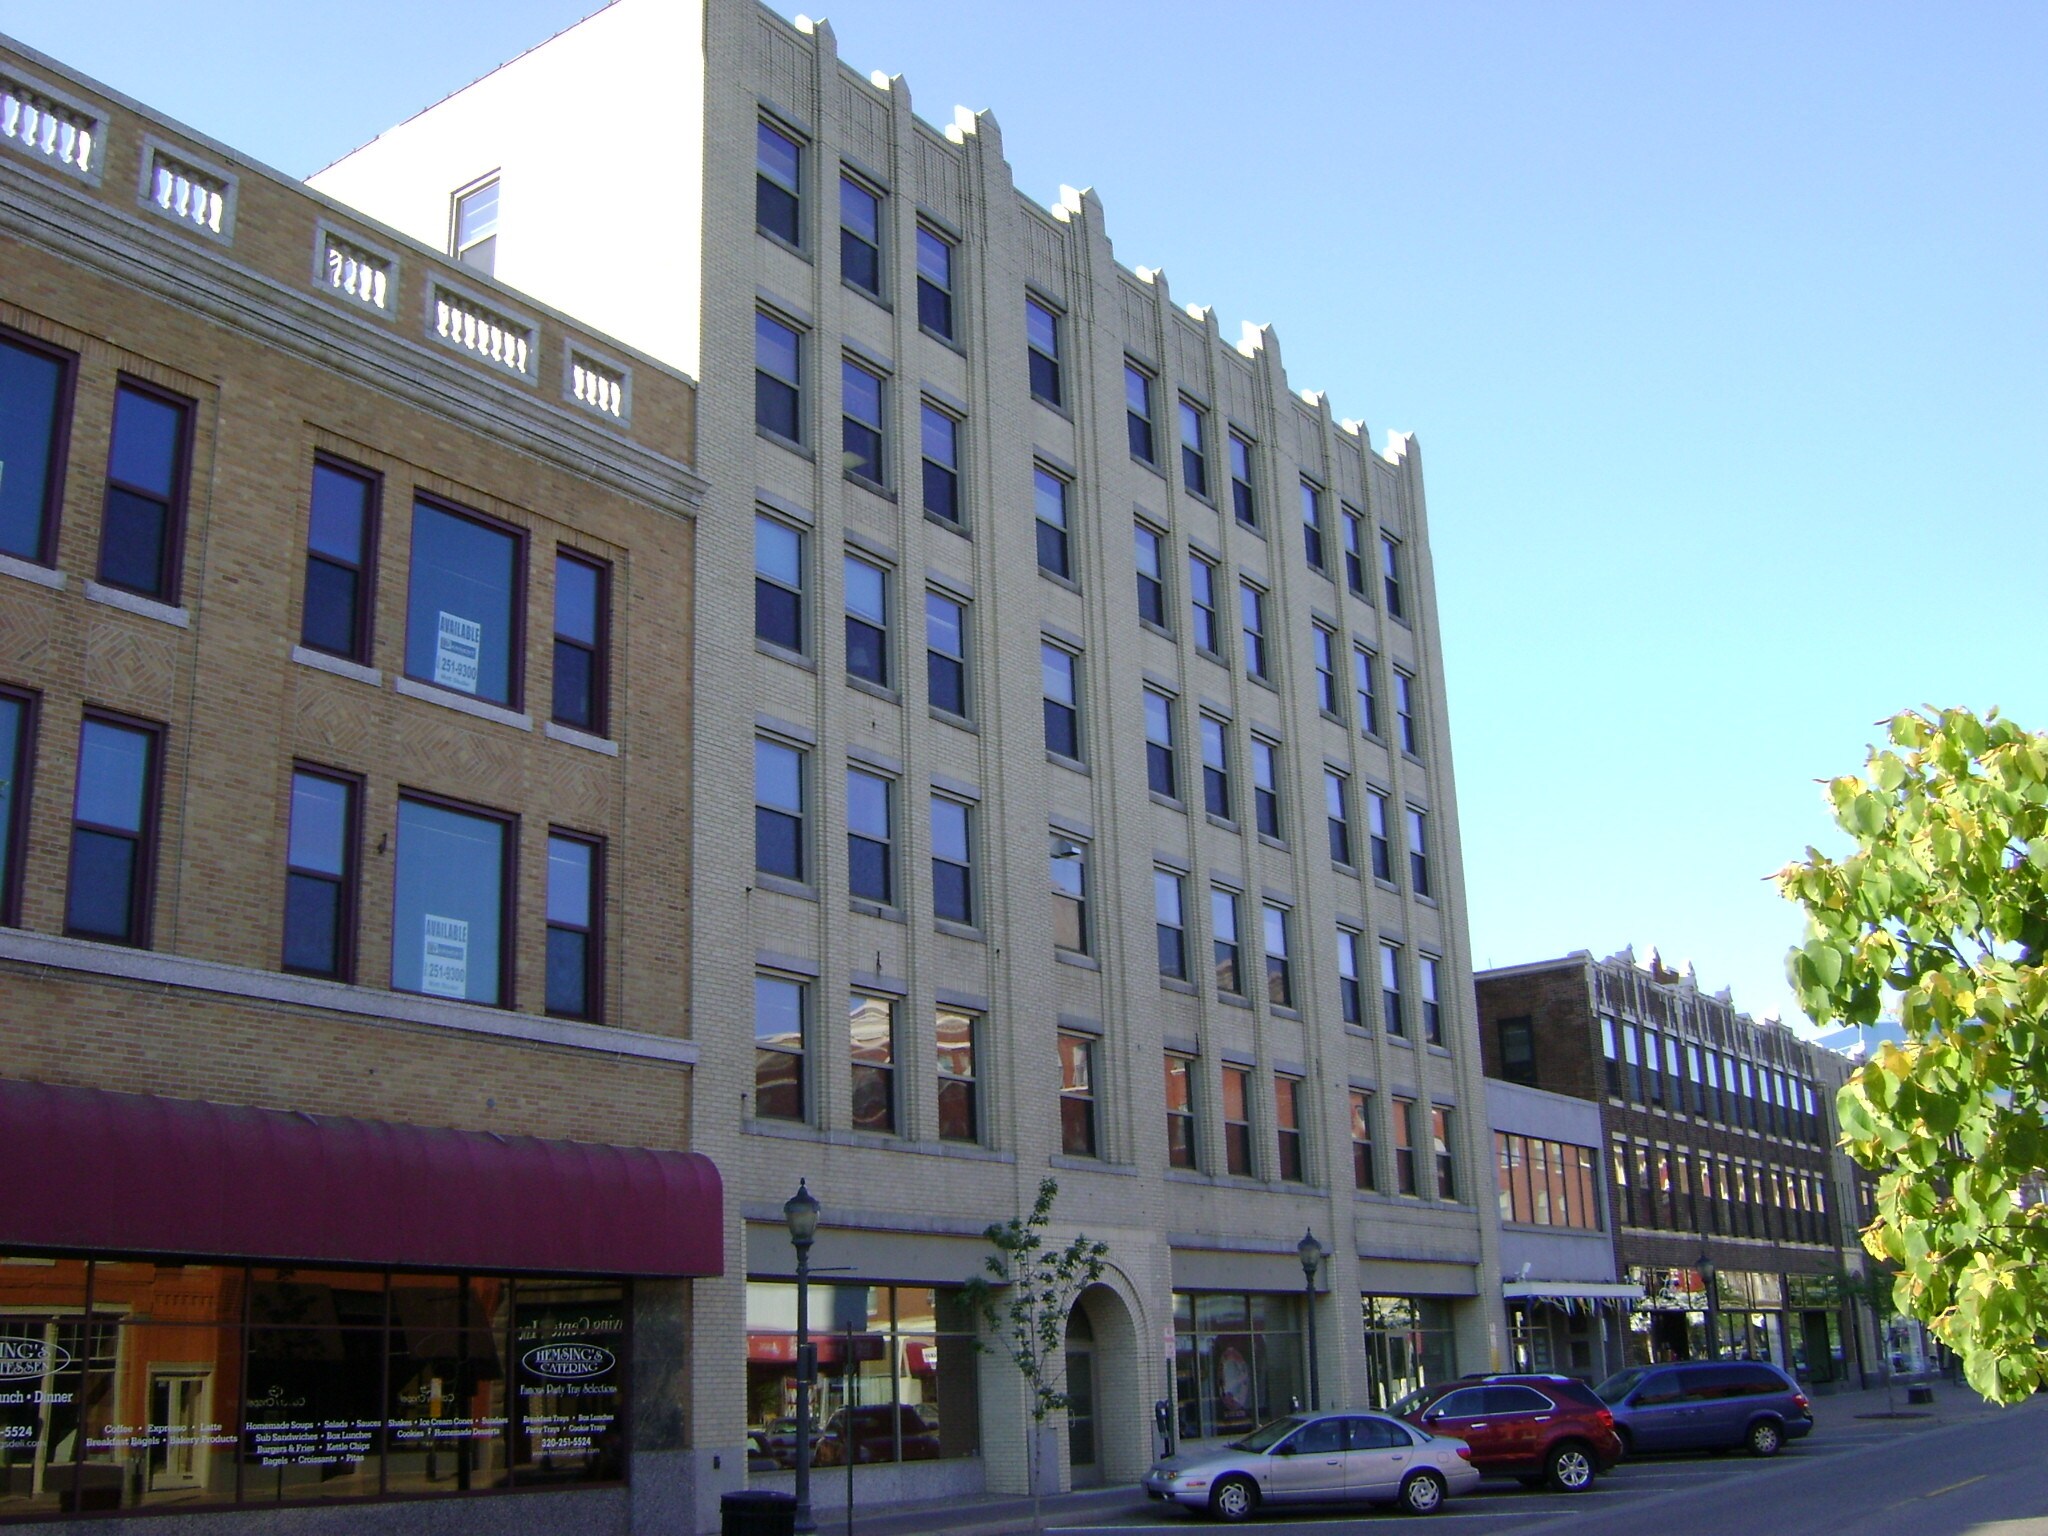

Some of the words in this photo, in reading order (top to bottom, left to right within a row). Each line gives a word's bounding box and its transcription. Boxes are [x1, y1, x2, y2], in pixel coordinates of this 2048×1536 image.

[440, 616, 480, 643] AVAILABLE
[441, 658, 477, 680] 251-9300
[426, 919, 467, 942] AVAILABLE
[429, 963, 465, 982] 251-9300
[536, 1347, 604, 1361] HEMSING'S
[540, 1362, 598, 1374] CATERING
[520, 1385, 545, 1394] Famous
[546, 1384, 565, 1397] Party
[567, 1384, 581, 1396] Tray
[583, 1383, 618, 1394] Selections
[33, 1390, 73, 1403] Dinner
[388, 1418, 413, 1427] Shakes
[419, 1418, 430, 1426] Ice
[431, 1418, 453, 1426] Cream
[453, 1417, 474, 1425] Cones
[481, 1416, 509, 1424] Sundaes
[523, 1415, 552, 1423] Breakfast
[553, 1414, 570, 1423] Trays
[578, 1414, 590, 1422] Box
[590, 1413, 614, 1422] Lunches
[104, 1424, 133, 1433] Coffee
[147, 1424, 187, 1434] Expresso
[200, 1423, 222, 1432] Latte
[246, 1421, 289, 1430] Homemade
[291, 1421, 314, 1430] Soups
[324, 1420, 348, 1428] Salads
[357, 1419, 382, 1427] Sauces
[525, 1425, 542, 1434] Party
[543, 1425, 560, 1434] Trays
[568, 1424, 589, 1432] Cookie
[590, 1424, 606, 1432] Trays
[255, 1433, 271, 1442] Sub
[272, 1432, 318, 1441] Sandwiches
[327, 1432, 341, 1440] Box
[342, 1431, 372, 1439] Lunches
[397, 1429, 424, 1438] Cookies
[434, 1428, 472, 1436] Homemade
[473, 1427, 500, 1435] Desserts
[86, 1437, 129, 1447] Breakfast
[131, 1436, 160, 1447] Bagels
[169, 1436, 199, 1446] Bakery
[201, 1434, 238, 1443] Products
[541, 1437, 592, 1448] 320-251-5524
[257, 1445, 287, 1454] Burgers
[296, 1444, 315, 1452] Fries
[326, 1443, 348, 1451] Kettle
[349, 1442, 370, 1451] Chips
[262, 1457, 288, 1466] Bagels
[298, 1455, 337, 1464] Croissants
[346, 1454, 364, 1462] Pitas
